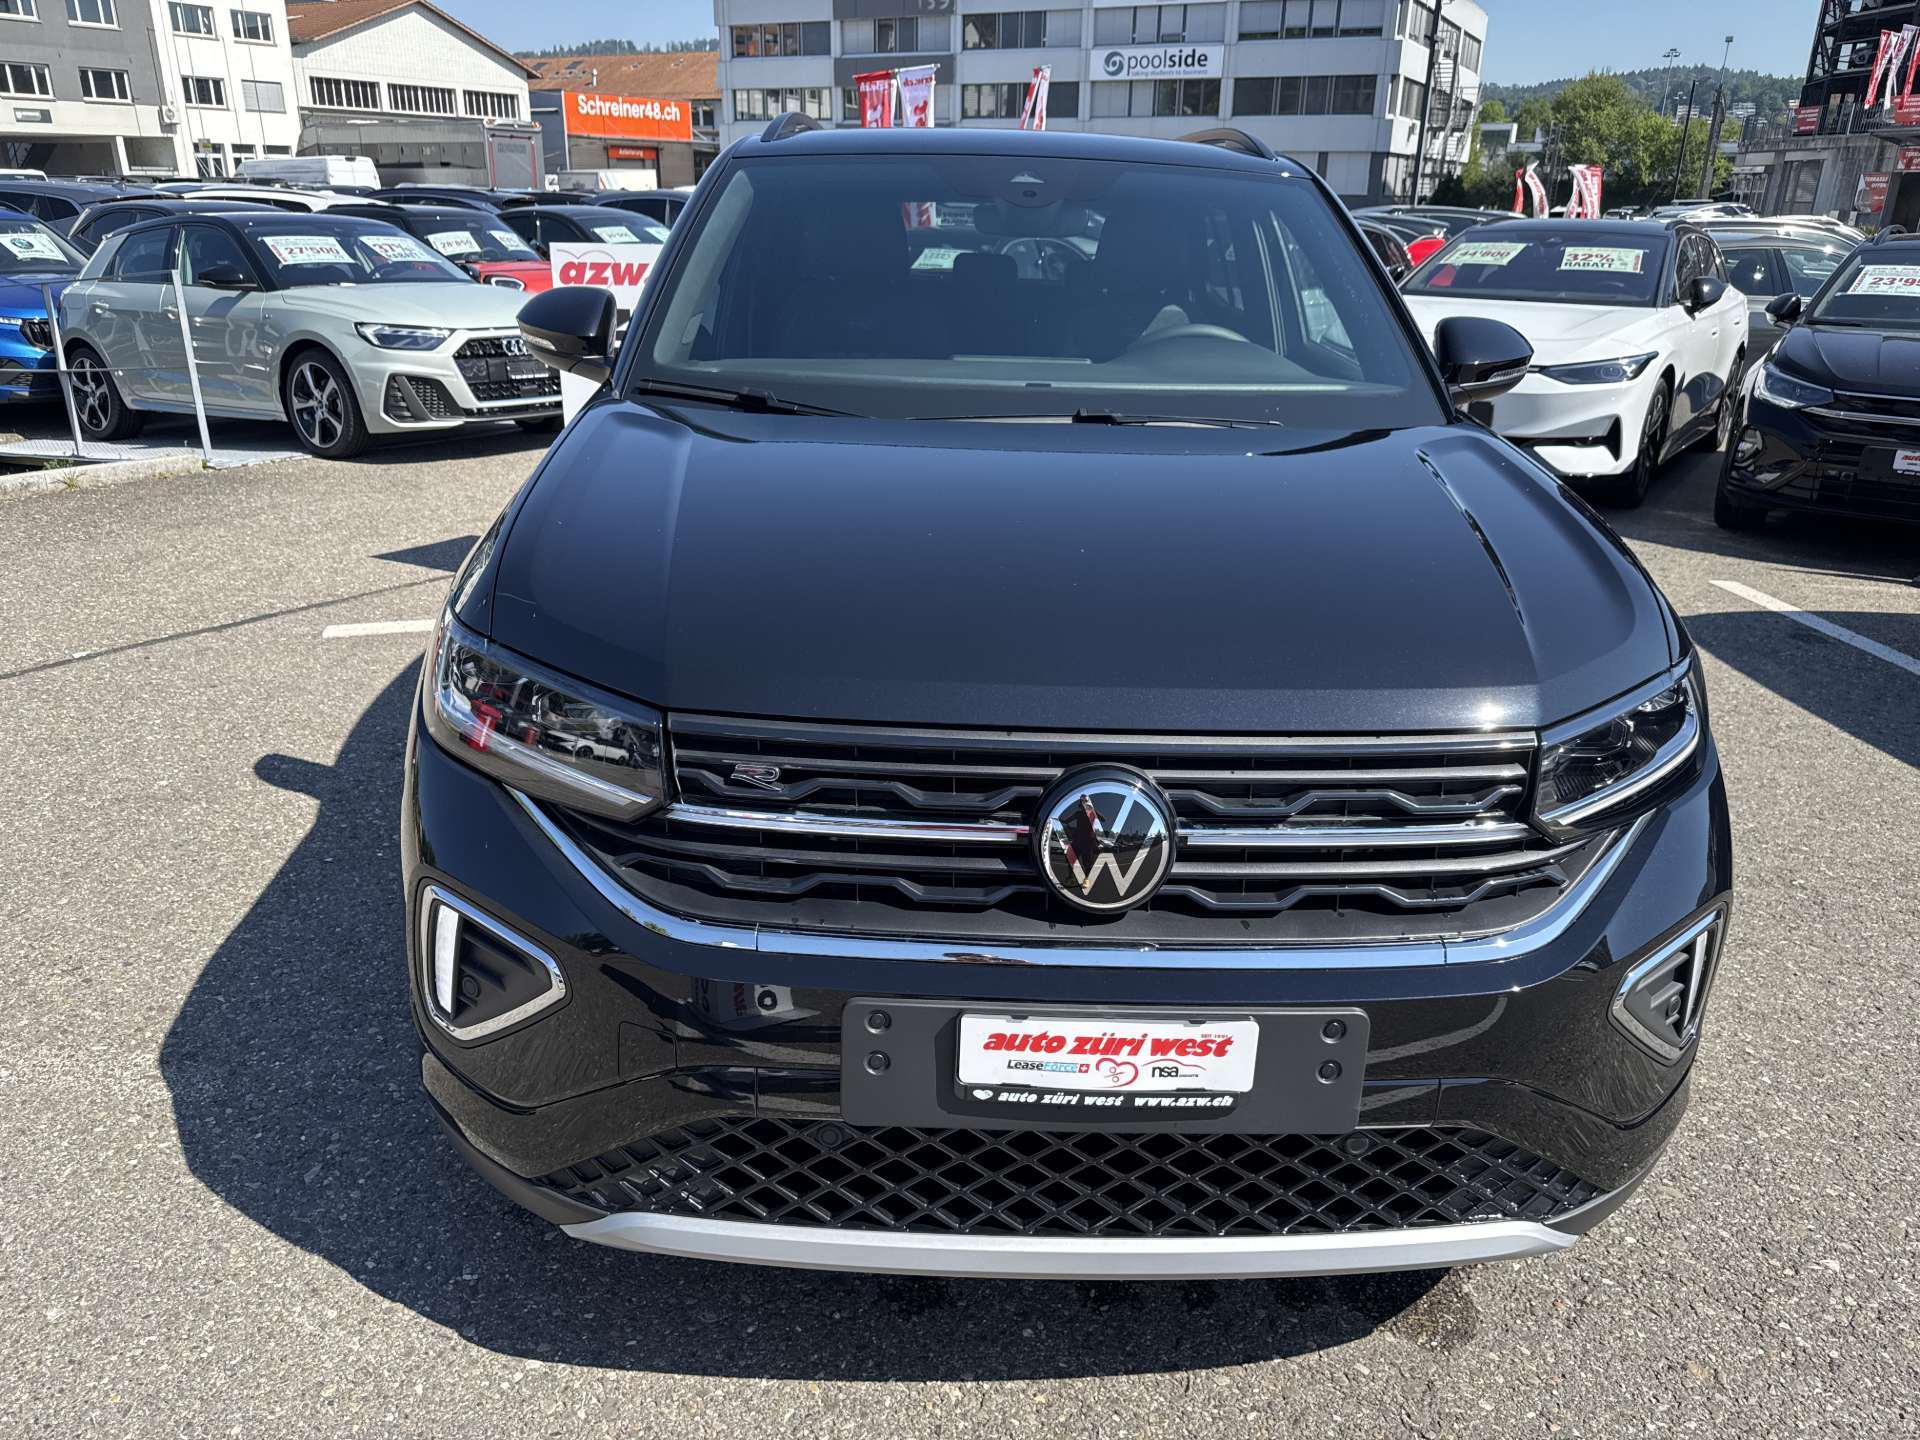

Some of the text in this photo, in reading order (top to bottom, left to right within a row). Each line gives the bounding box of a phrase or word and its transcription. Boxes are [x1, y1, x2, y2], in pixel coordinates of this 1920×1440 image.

[1127, 48, 1208, 76] poolside
[577, 94, 681, 121] Schreiner48.ch
[284, 245, 340, 256] 27'500
[1566, 253, 1615, 262] 32%
[1564, 261, 1614, 269] RABATT
[983, 1031, 1234, 1057] auto züri west
[1007, 1059, 1078, 1073] LeaseForce
[1152, 1066, 1179, 1078] nsa
[998, 1092, 1234, 1107] auto züri west www.azw.ch
